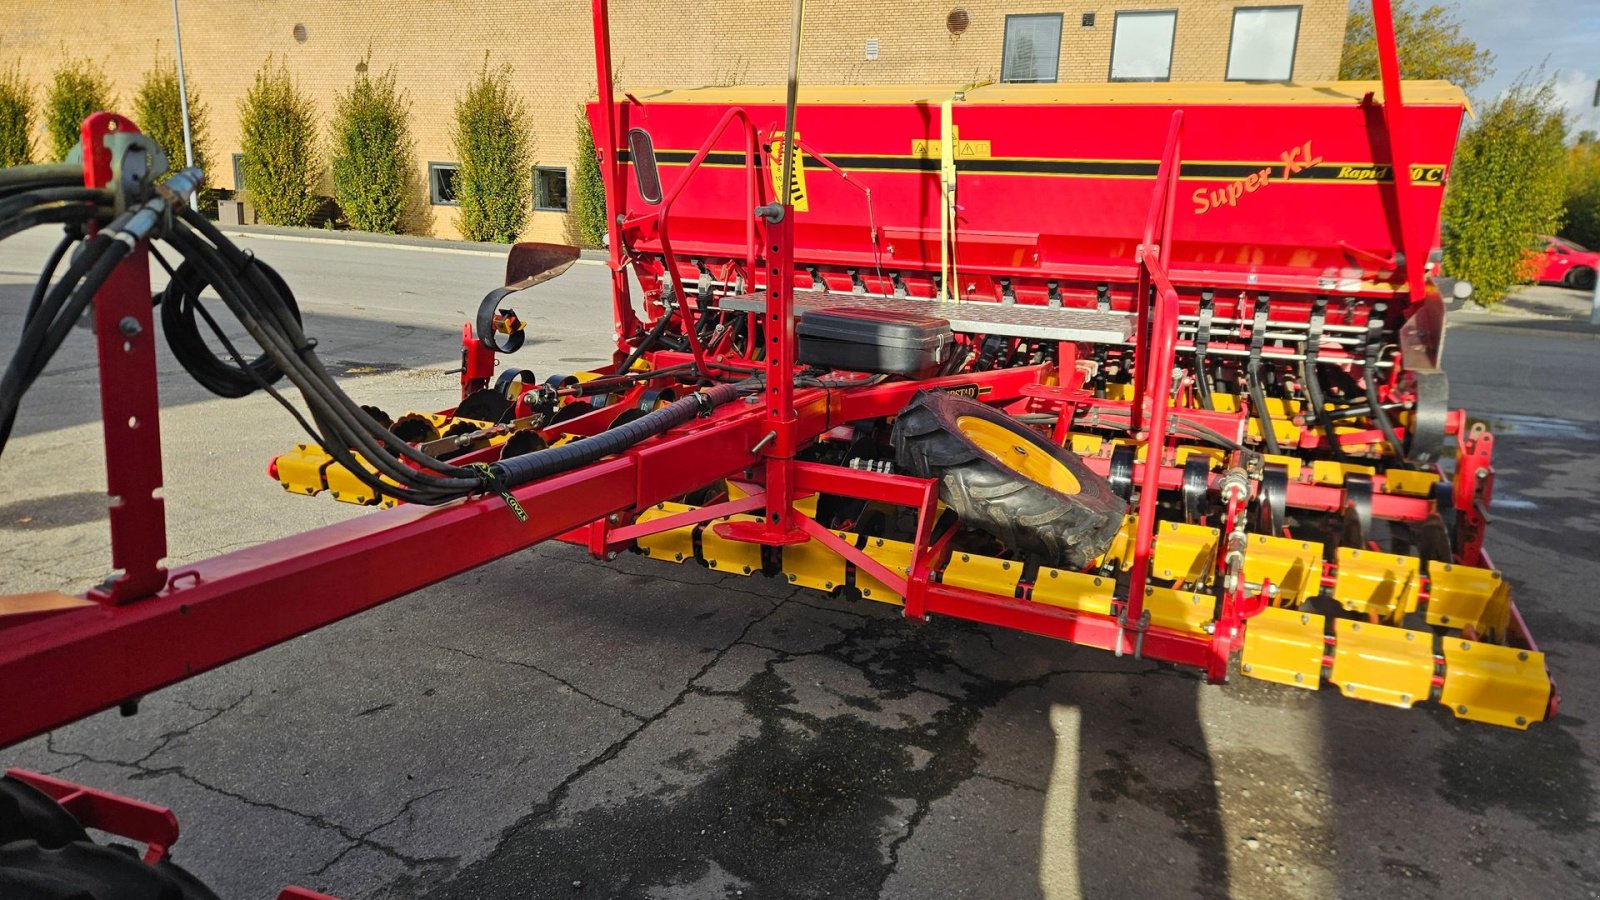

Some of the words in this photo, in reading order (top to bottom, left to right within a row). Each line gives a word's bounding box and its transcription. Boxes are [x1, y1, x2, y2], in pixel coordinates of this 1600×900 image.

[1192, 167, 1272, 215] Super
[1279, 140, 1323, 180] XL
[1336, 166, 1387, 180] Rapid
[1426, 168, 1442, 181] C
